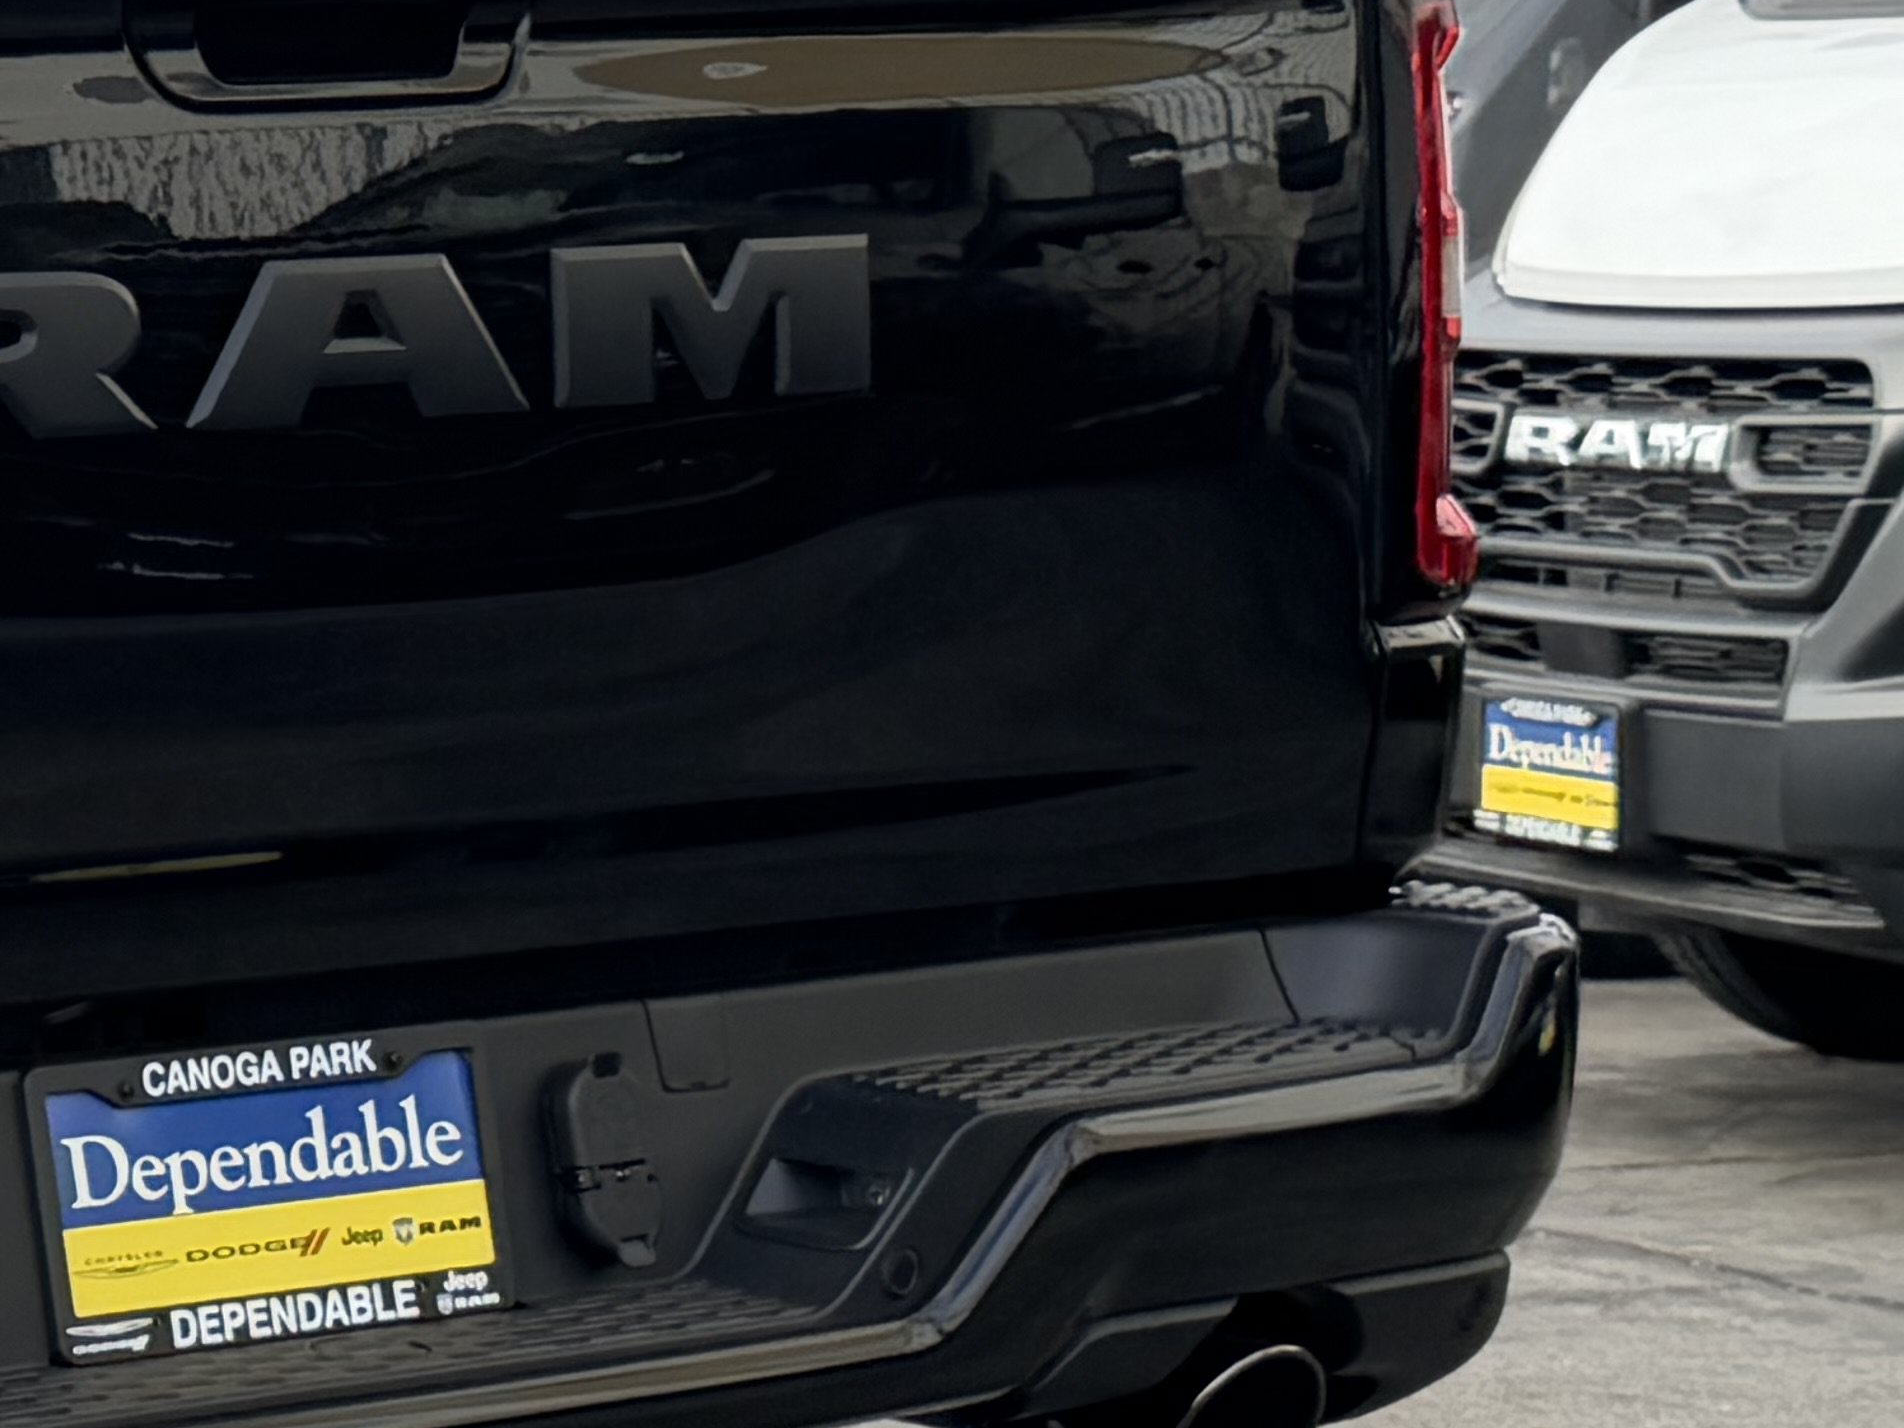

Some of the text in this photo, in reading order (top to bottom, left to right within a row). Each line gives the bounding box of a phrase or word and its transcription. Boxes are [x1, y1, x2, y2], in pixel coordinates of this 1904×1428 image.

[1504, 415, 1730, 473] RAM
[141, 1038, 377, 1097] CANOGA PARK
[60, 1092, 465, 1216] Dependable
[341, 1226, 384, 1248] Jeep
[419, 1215, 482, 1236] RAM
[185, 1236, 309, 1264] DODGE
[443, 1269, 489, 1292] Jeep
[169, 1278, 421, 1350] DEPENDABLE
